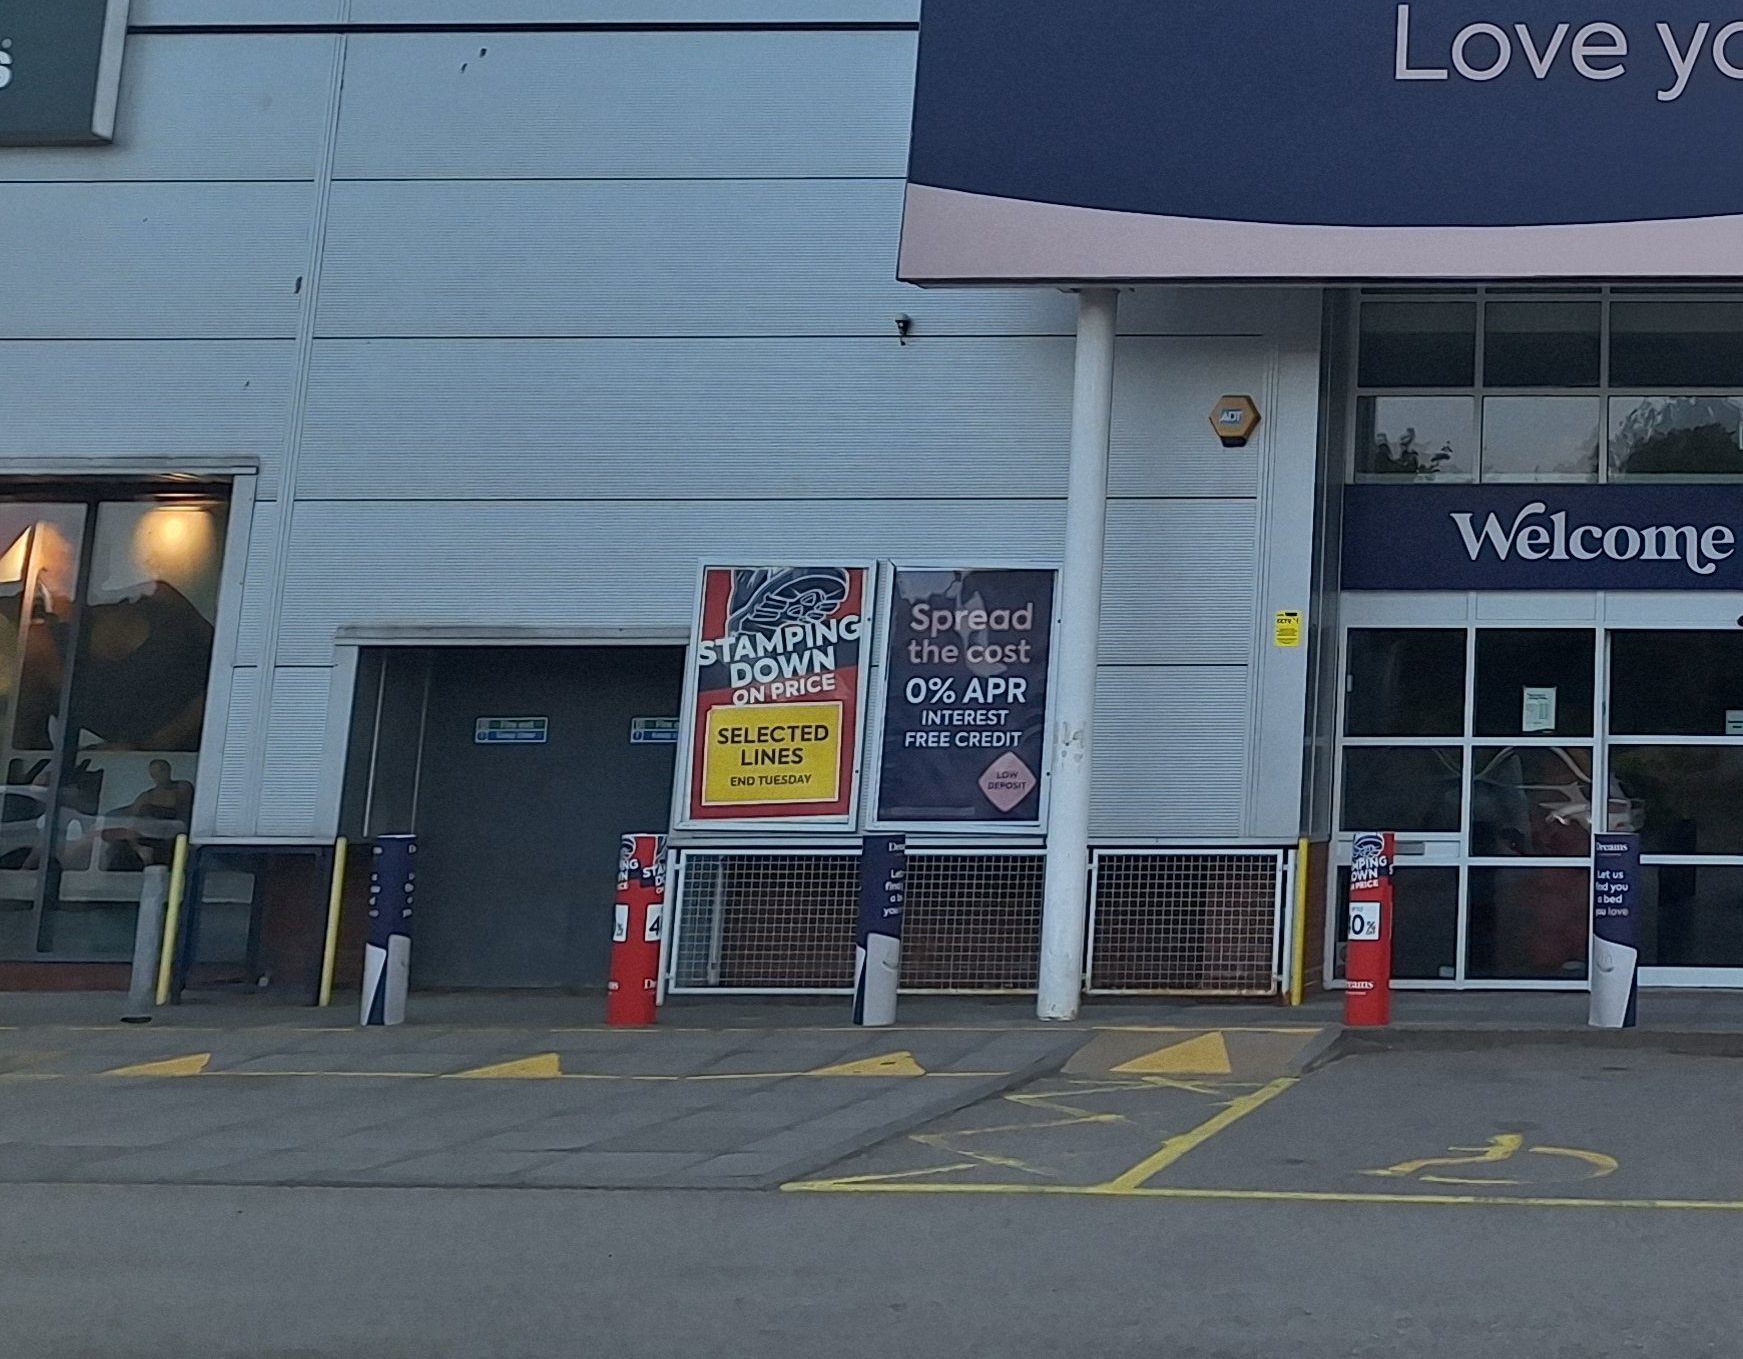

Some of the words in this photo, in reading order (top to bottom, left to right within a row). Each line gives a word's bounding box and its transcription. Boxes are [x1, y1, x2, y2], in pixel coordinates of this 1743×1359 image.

[1395, 3, 1629, 81] Love
[1219, 410, 1243, 423] ADT
[1450, 502, 1735, 574] Welcome
[910, 602, 1034, 638] Spread
[699, 614, 862, 666] STAMPING
[908, 639, 959, 663] the
[966, 639, 1032, 663] cost
[730, 646, 836, 688] DOWN
[732, 685, 765, 706] ON
[771, 673, 836, 700] PRICE
[905, 677, 956, 704] 0%
[962, 677, 1028, 704] APR
[921, 709, 1010, 726] INTEREST
[717, 724, 829, 745] SELECTED
[904, 731, 951, 747] FREE
[954, 731, 1023, 747] CREDIT
[740, 747, 804, 766] LINES
[730, 776, 756, 787] END
[757, 774, 812, 787] TUESDAY
[995, 771, 1019, 780] LOW
[987, 781, 1027, 790] DEPOSIT
[1612, 871, 1624, 879] us
[1610, 884, 1629, 893] you
[1604, 894, 1623, 903] bed
[1608, 906, 1629, 916] love
